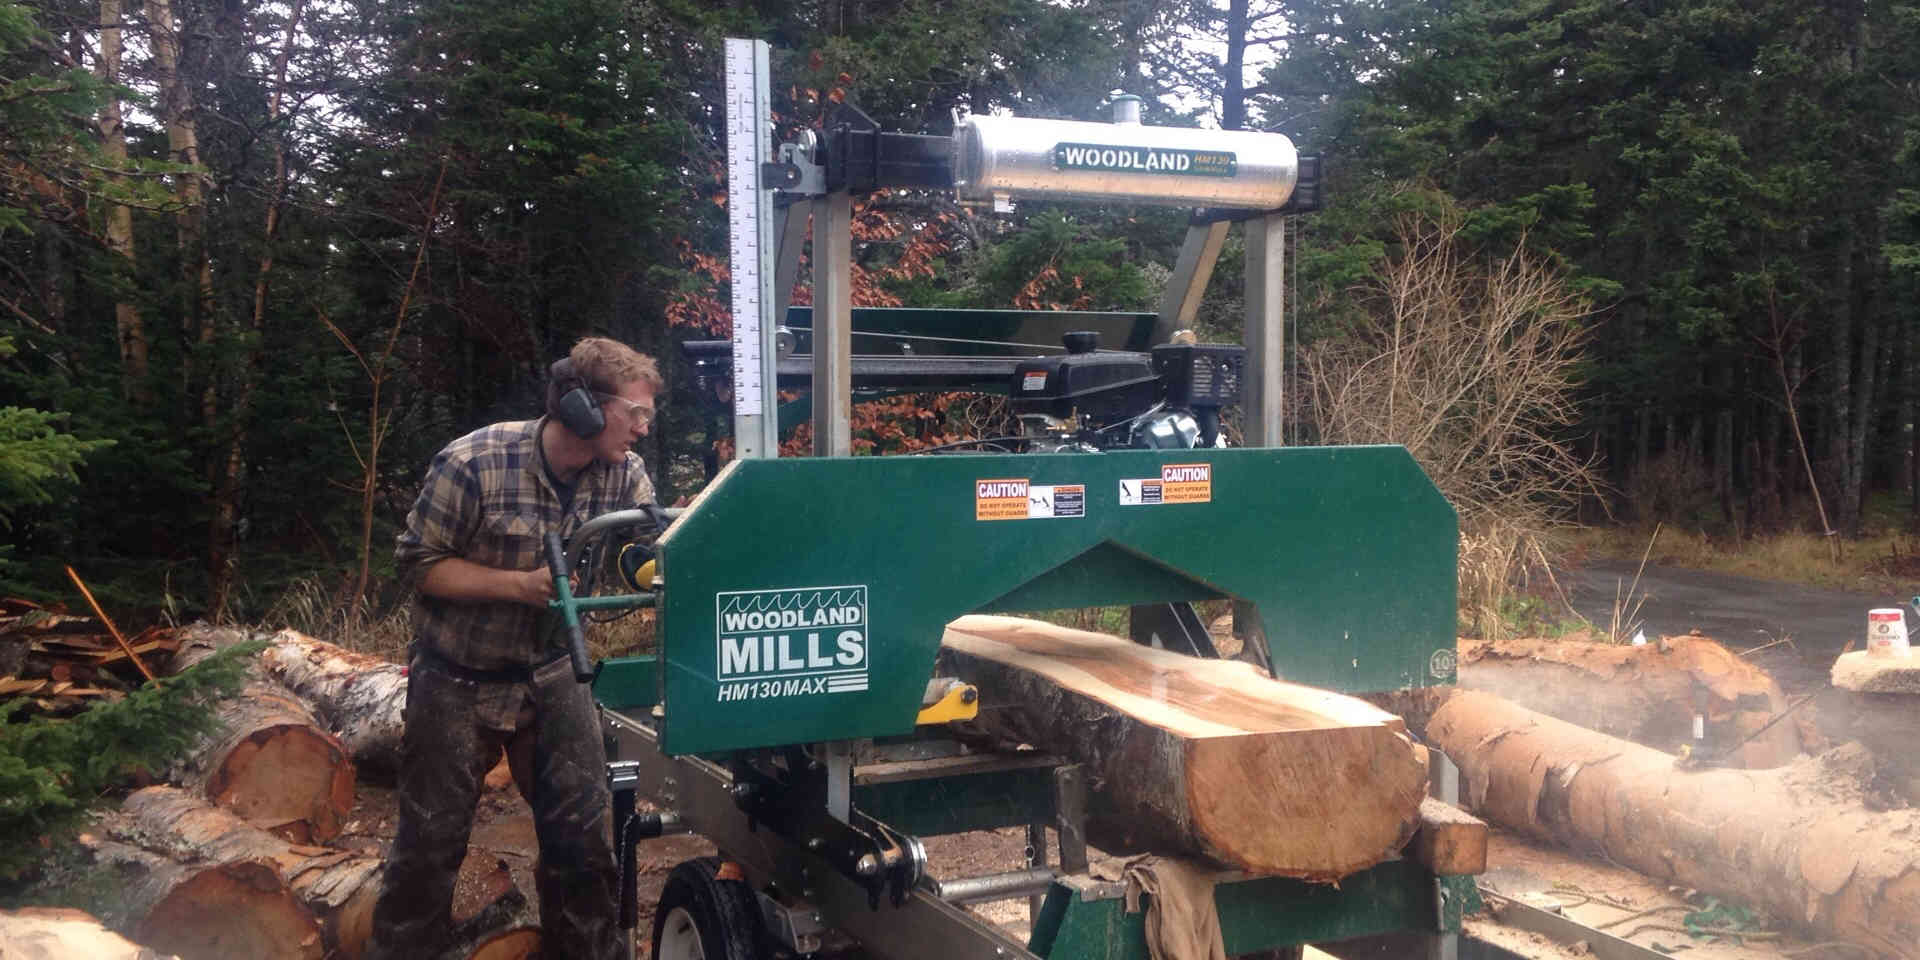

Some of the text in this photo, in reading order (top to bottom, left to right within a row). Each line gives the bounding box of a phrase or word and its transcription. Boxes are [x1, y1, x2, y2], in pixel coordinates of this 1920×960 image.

[1065, 147, 1190, 171] WOODLAND
[1164, 467, 1208, 482] CAUTION
[979, 483, 1027, 498] CAUTION
[725, 606, 860, 631] WOODLAND
[721, 630, 865, 674] MILLS
